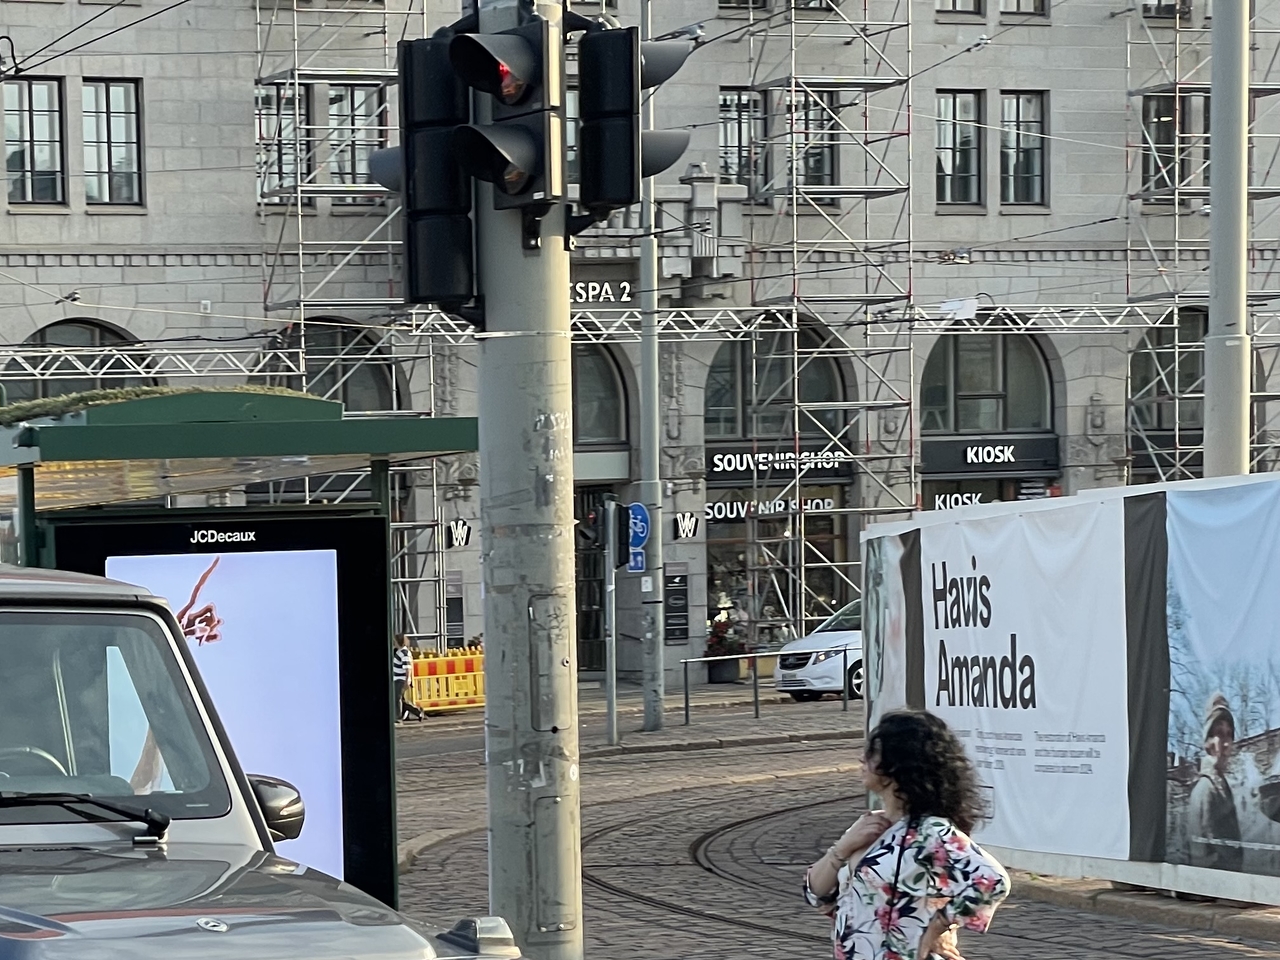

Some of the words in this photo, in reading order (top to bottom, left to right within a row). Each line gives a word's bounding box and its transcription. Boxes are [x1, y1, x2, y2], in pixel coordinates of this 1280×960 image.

[620, 281, 631, 302] 2
[713, 452, 796, 472] SOUVENIR
[800, 451, 845, 469] SHOP
[966, 445, 1015, 464] KIOSK
[934, 492, 982, 511] KIOSK
[190, 530, 256, 544] JCDecaux
[932, 555, 992, 629] Havis
[936, 633, 1037, 709] Amanda
